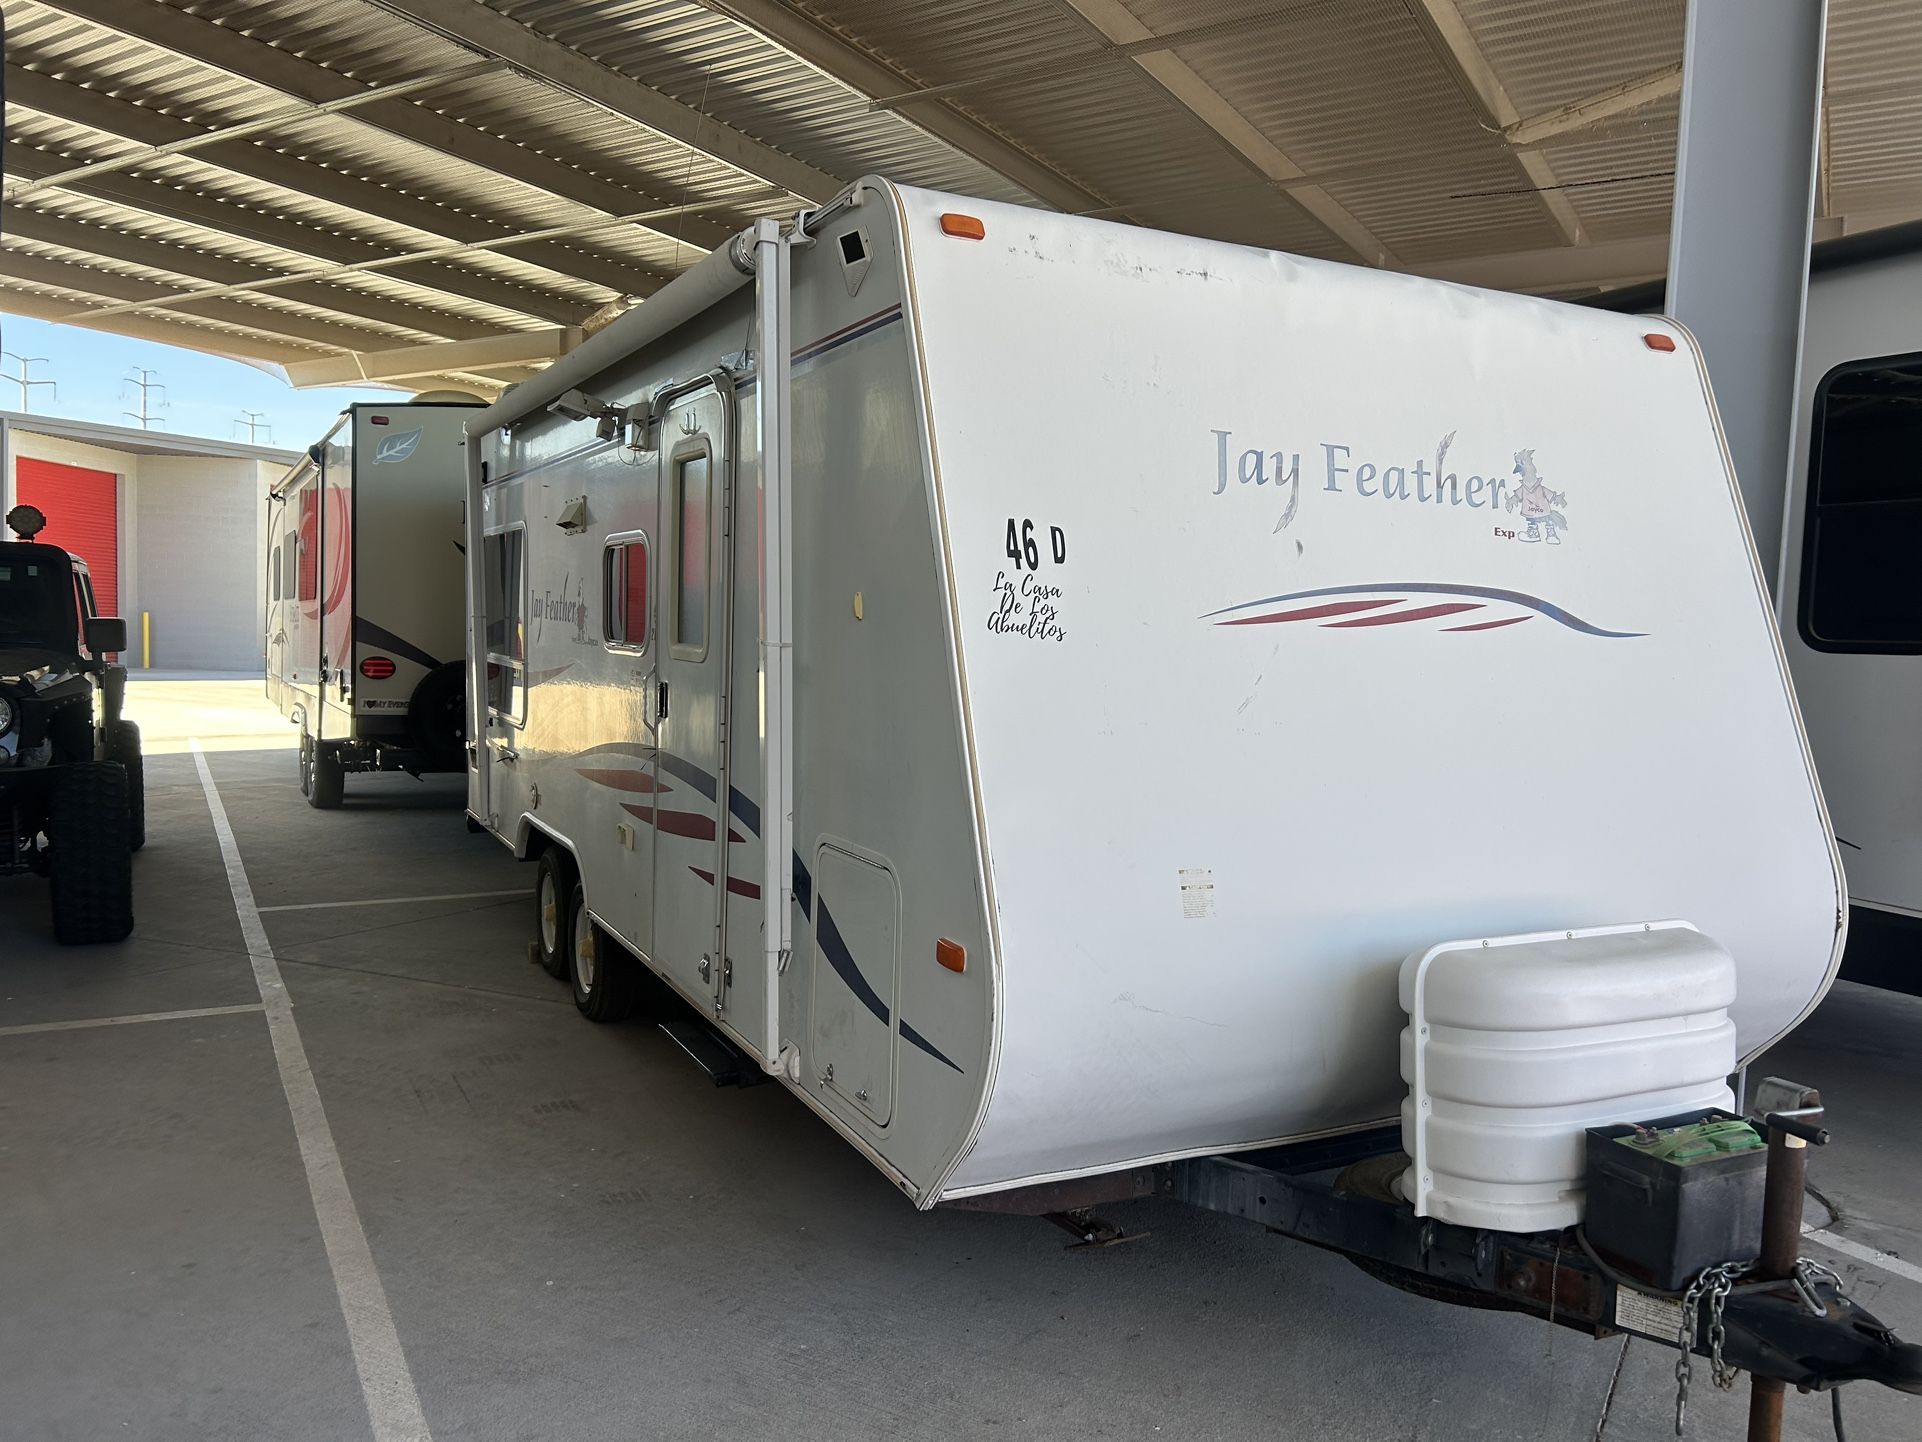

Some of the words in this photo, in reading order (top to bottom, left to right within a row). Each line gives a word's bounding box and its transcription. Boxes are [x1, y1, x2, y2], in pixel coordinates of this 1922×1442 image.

[1210, 429, 1300, 534] Jay
[1320, 430, 1506, 510] Feather
[1006, 518, 1039, 571] 46
[1050, 525, 1066, 564] D
[1494, 527, 1515, 539] Exp
[993, 571, 1016, 593] La
[1021, 573, 1062, 600] Casa
[530, 589, 544, 645] Jay
[545, 571, 577, 623] Feather
[1000, 592, 1023, 614] De
[1029, 595, 1058, 620] Los
[987, 608, 1067, 642] Abuelitos
